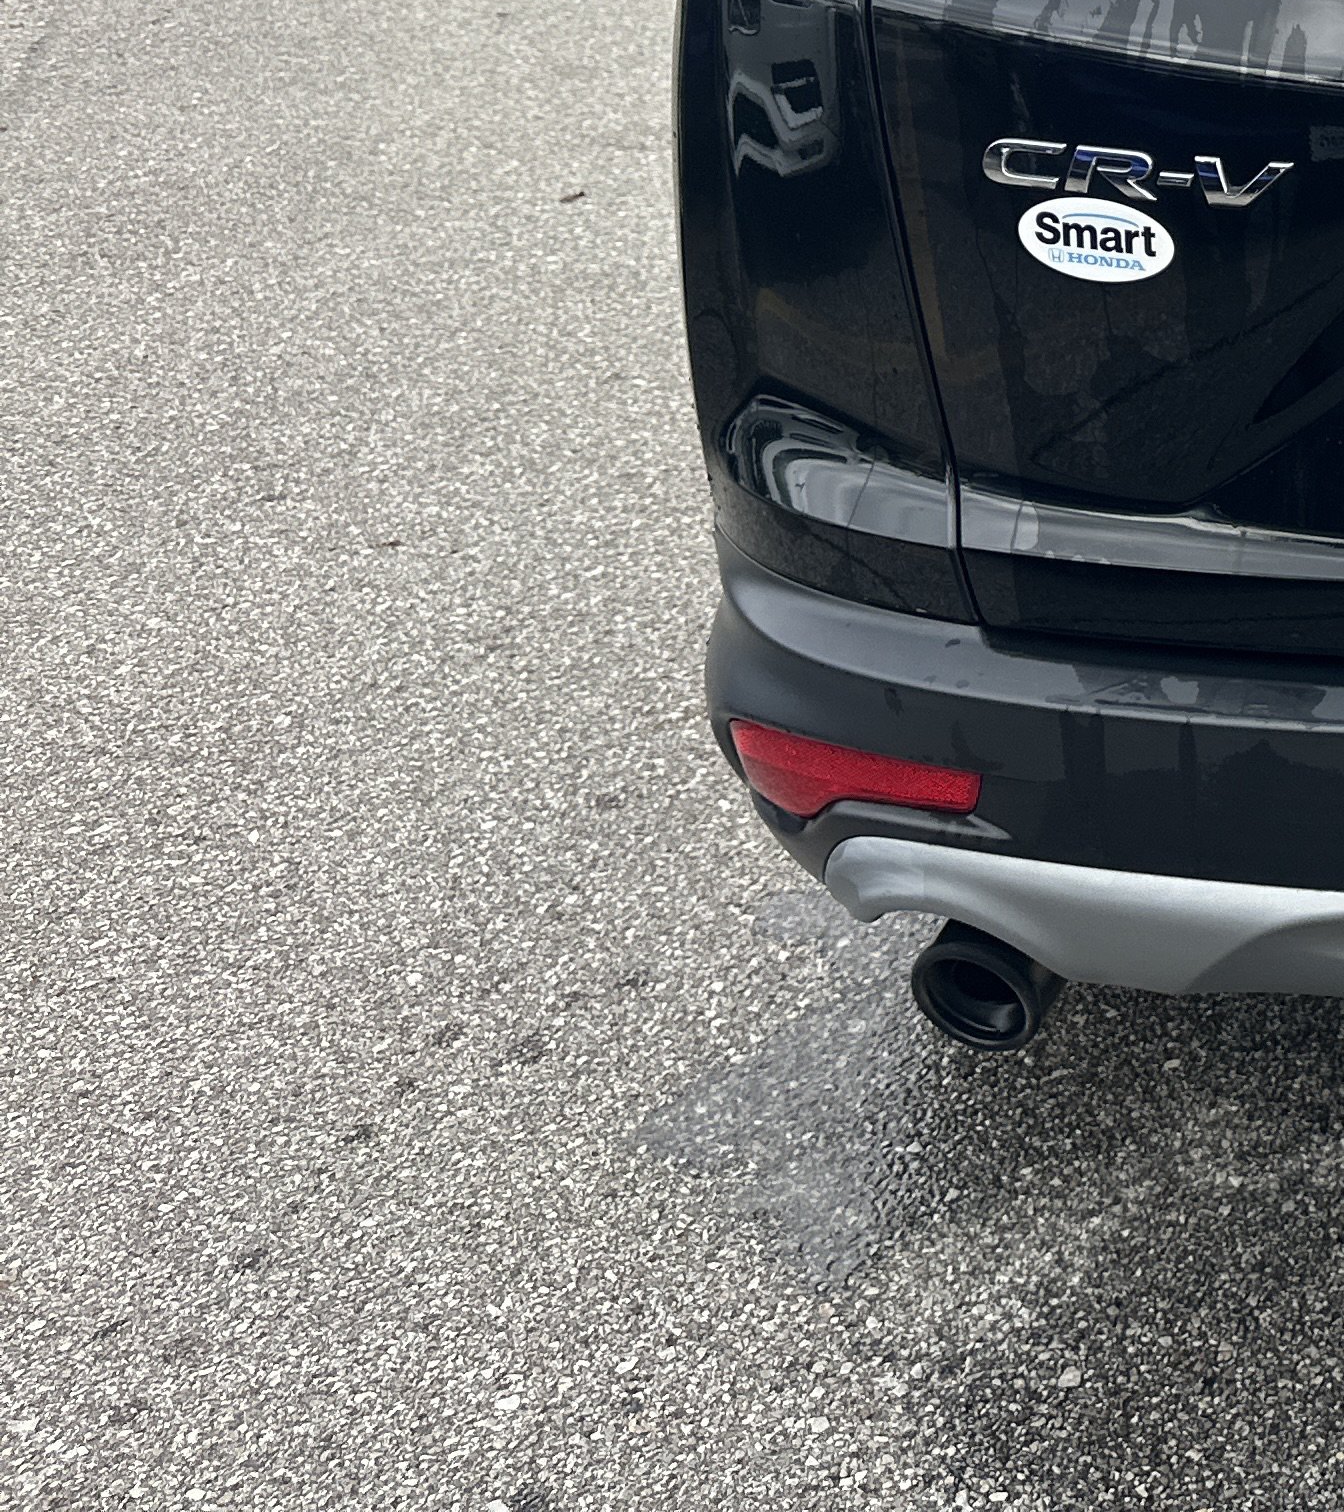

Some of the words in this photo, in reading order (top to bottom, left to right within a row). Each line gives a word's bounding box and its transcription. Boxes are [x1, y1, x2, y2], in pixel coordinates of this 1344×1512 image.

[982, 137, 1295, 208] CR-V
[1034, 211, 1157, 257] Smart
[1067, 251, 1147, 272] HONDA
